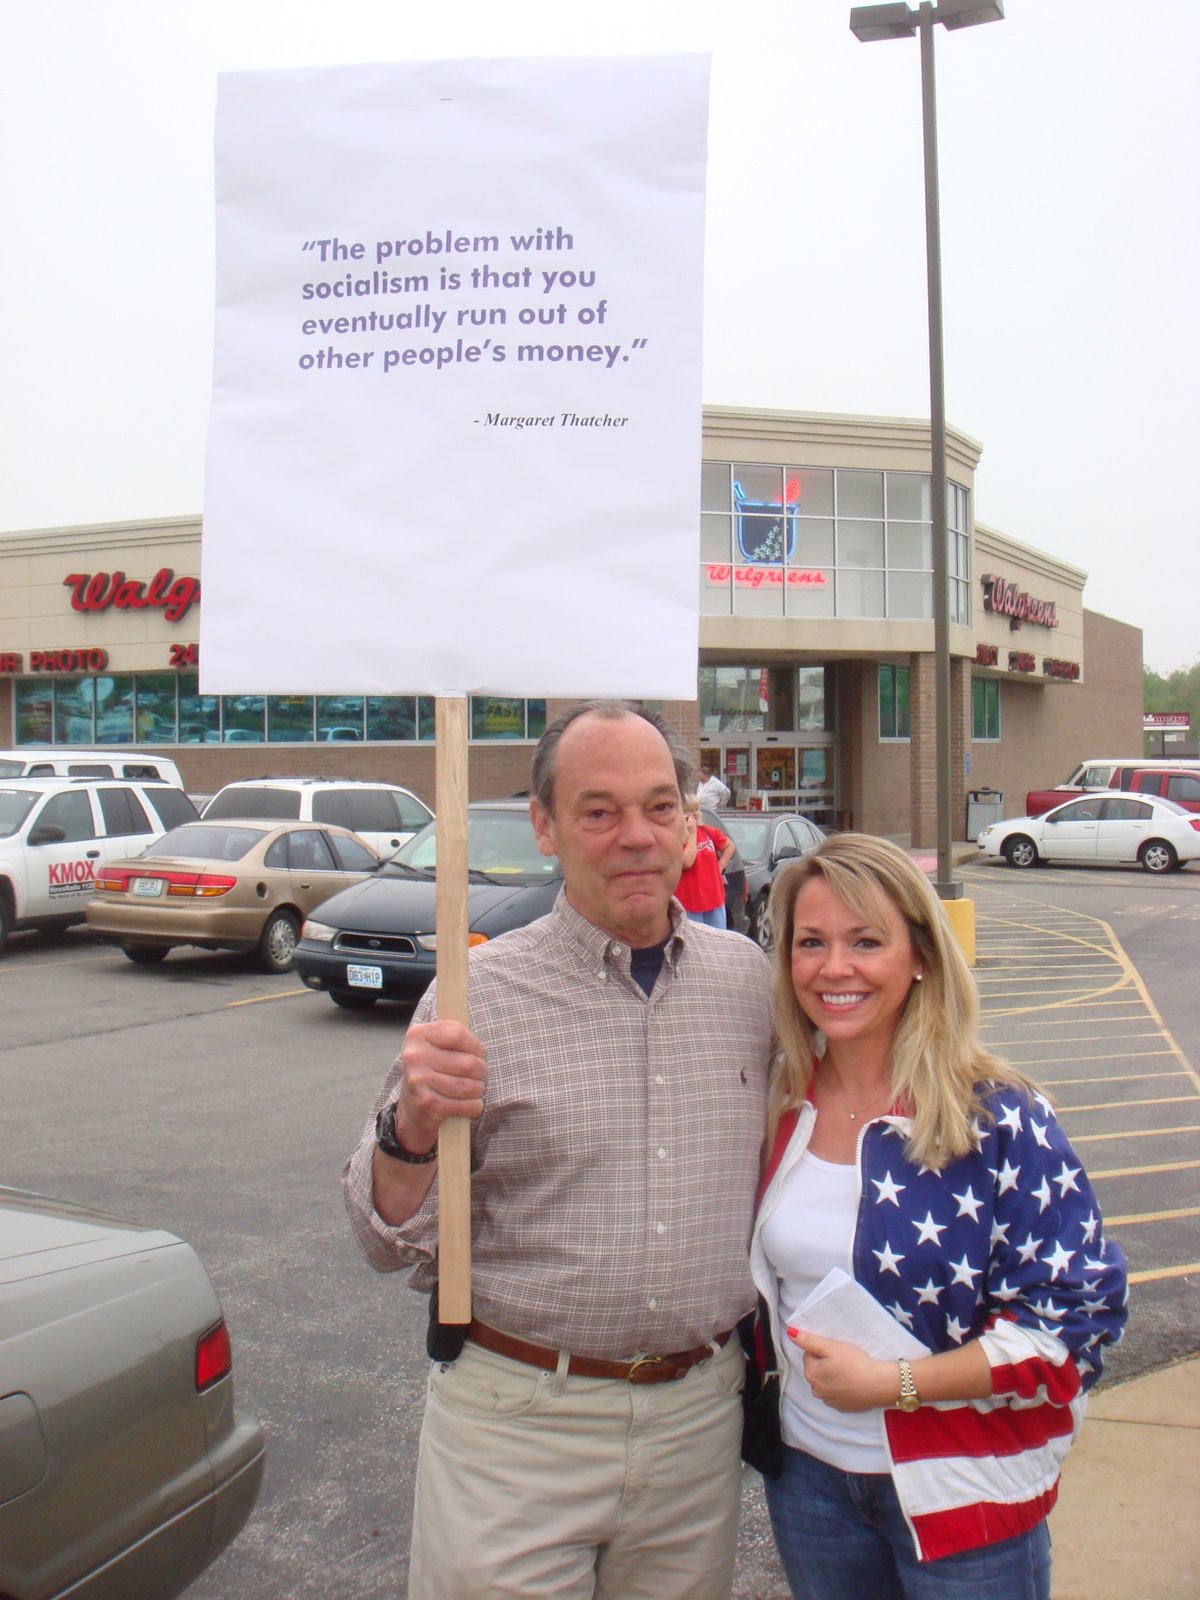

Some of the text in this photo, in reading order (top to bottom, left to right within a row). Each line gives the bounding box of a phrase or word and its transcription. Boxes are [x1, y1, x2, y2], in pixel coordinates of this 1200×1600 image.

[301, 226, 574, 264] “The problem with
[301, 264, 596, 301] socialism is that you
[301, 299, 608, 336] eventually run out of
[298, 337, 649, 374] other people’s money.”
[484, 413, 555, 431] Margaret
[560, 412, 629, 429] Thatcher
[63, 567, 200, 623] Walg
[706, 564, 828, 590] Walgreens
[30, 648, 108, 673] PHOTO
[48, 860, 95, 885] KMOX
